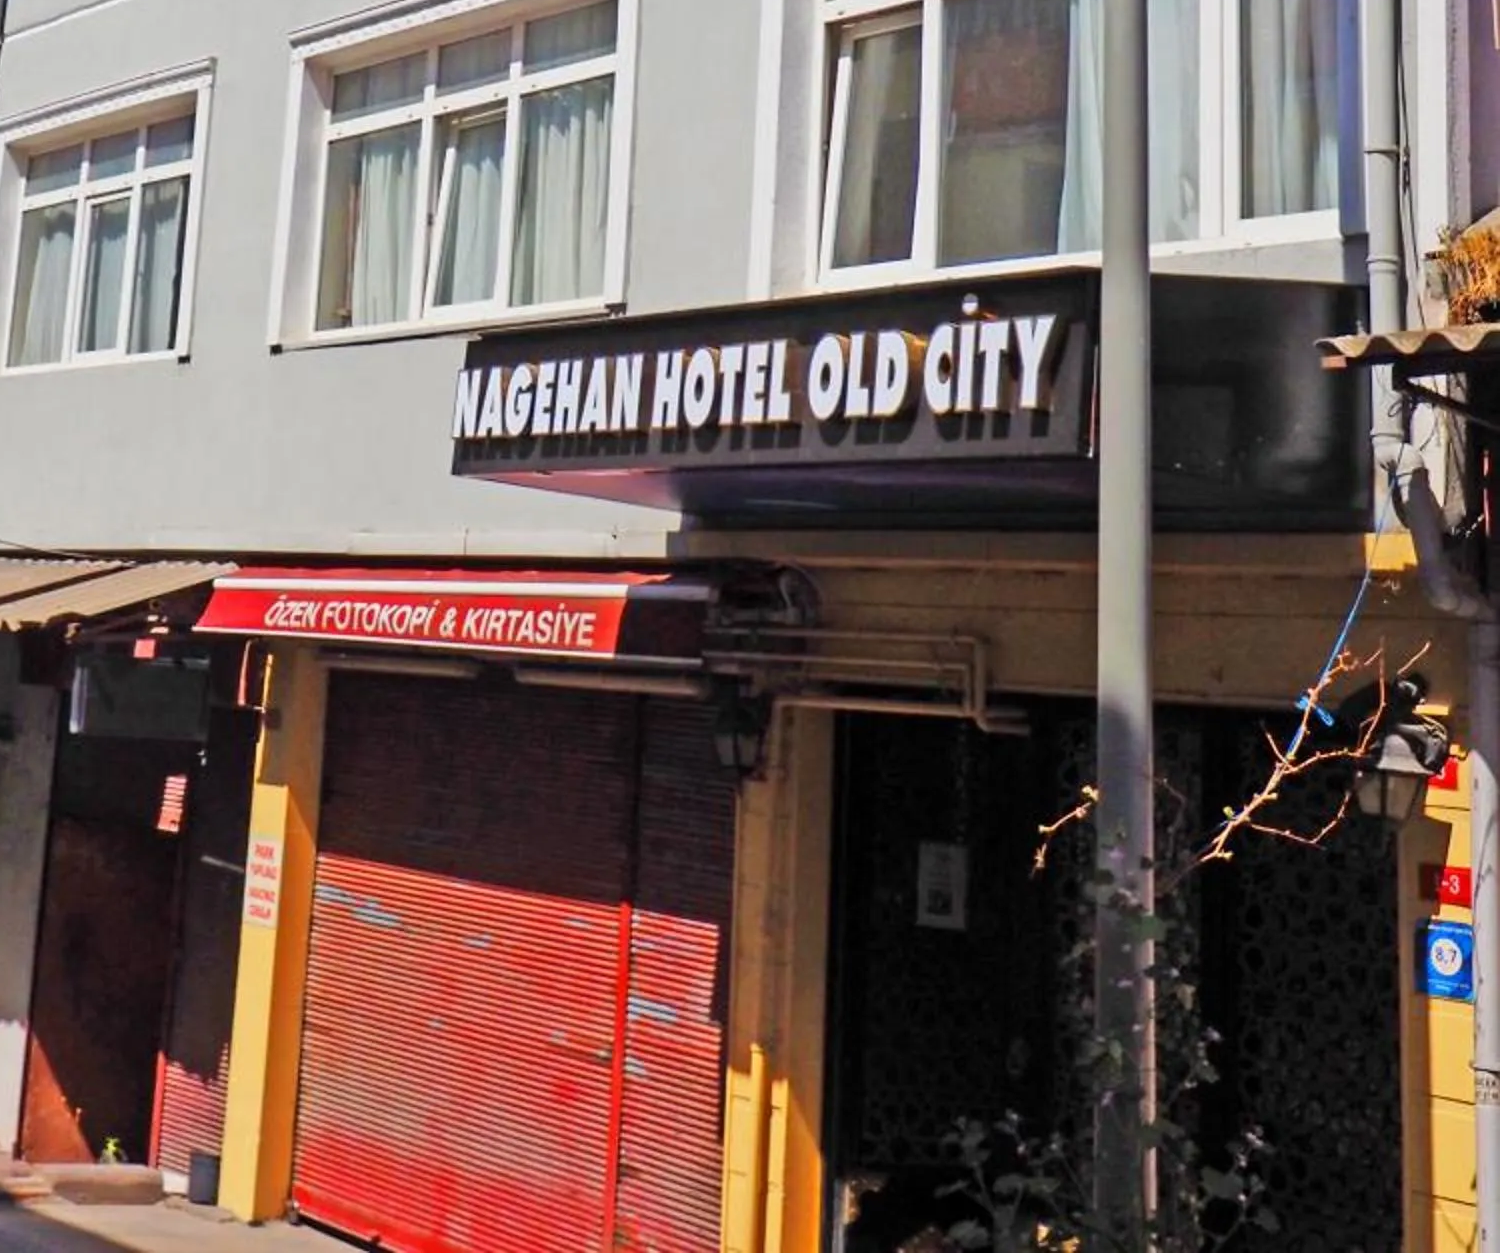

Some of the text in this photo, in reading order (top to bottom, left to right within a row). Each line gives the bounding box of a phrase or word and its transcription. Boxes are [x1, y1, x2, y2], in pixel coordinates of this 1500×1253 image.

[453, 353, 643, 438] NAGEHAN
[651, 338, 792, 428] HOTEL
[807, 331, 910, 420] OLD
[263, 594, 597, 647] ÖZEN FOTOKOPİ & KIRTASİYE
